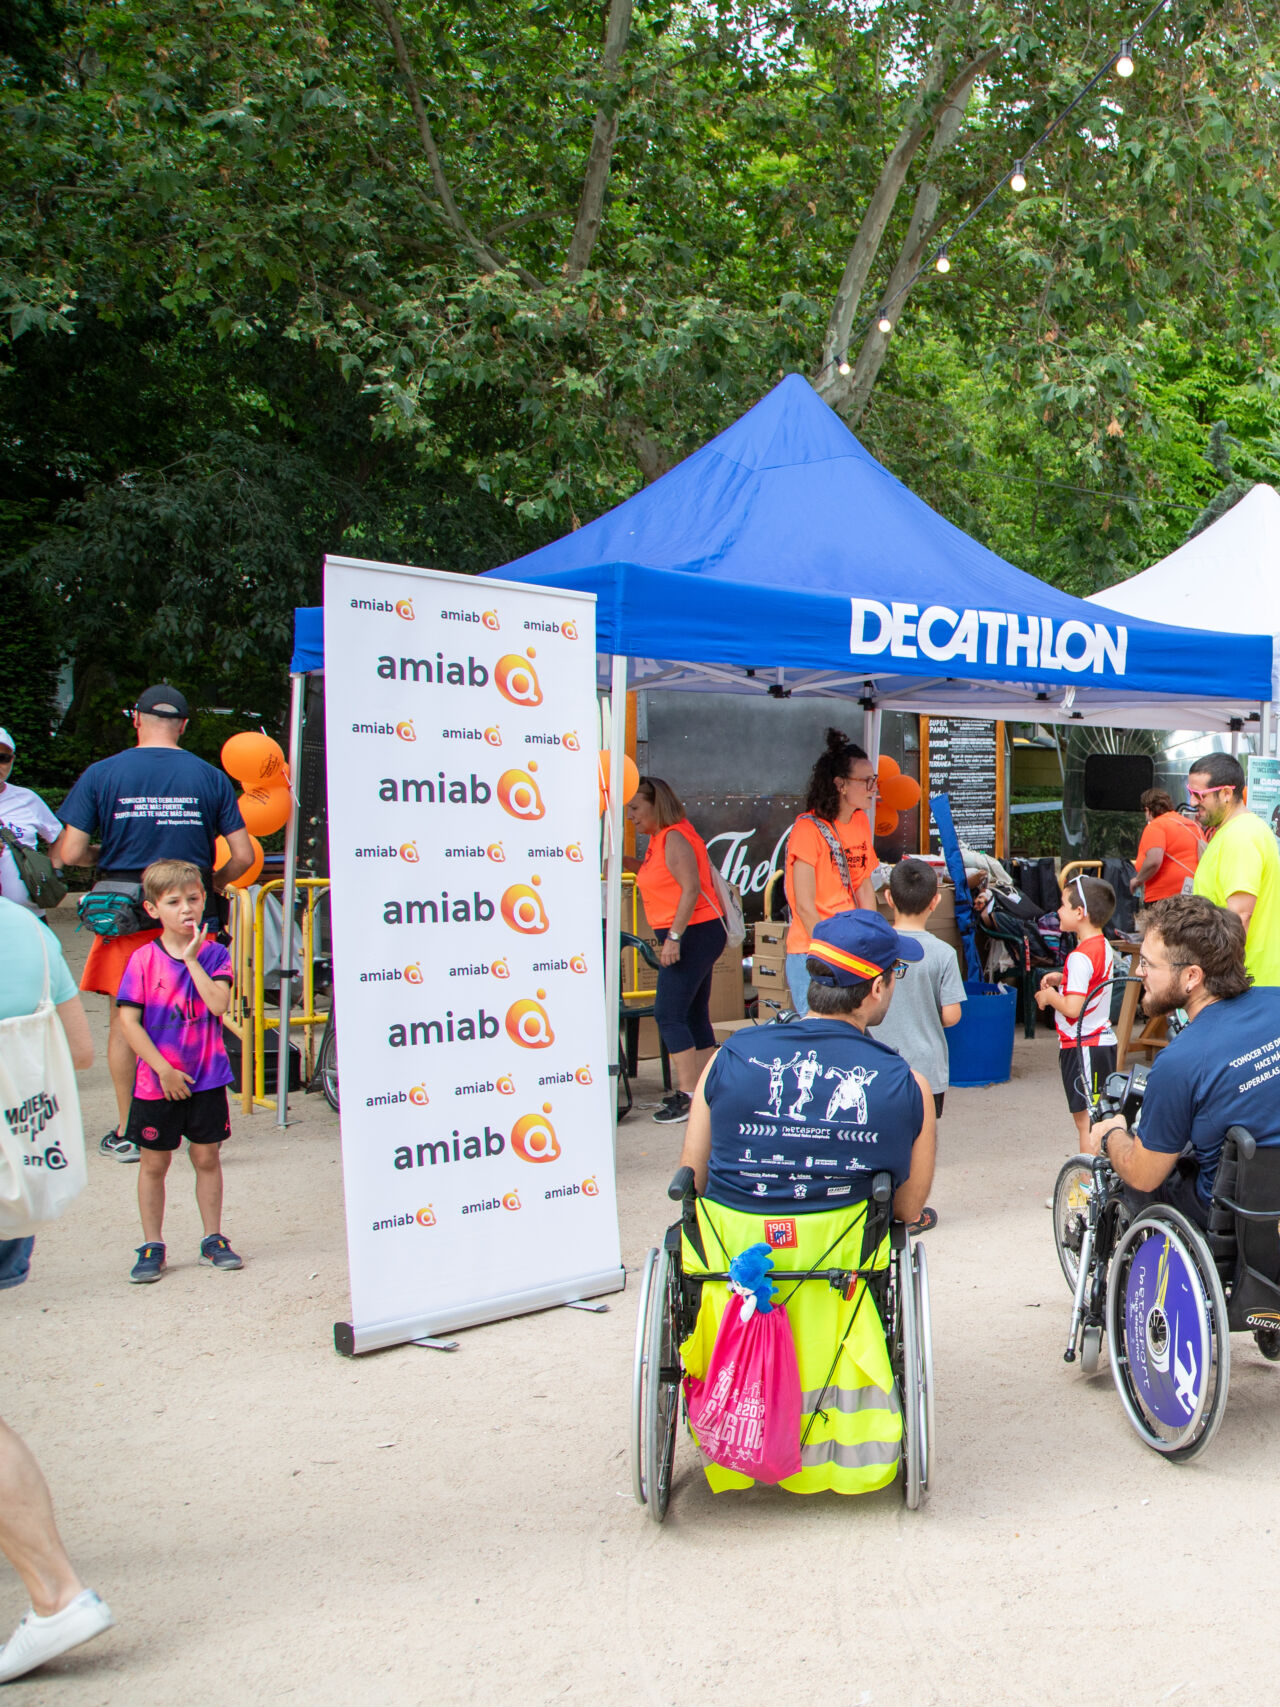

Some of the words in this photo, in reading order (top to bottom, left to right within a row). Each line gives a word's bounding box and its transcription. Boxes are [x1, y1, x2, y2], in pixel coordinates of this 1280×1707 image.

[350, 598, 394, 613] amiab
[440, 610, 480, 623] amiab
[523, 620, 559, 633] amiab
[850, 598, 1128, 675] DECATHLON
[377, 652, 489, 688] amiab
[352, 722, 394, 735] amiab
[442, 729, 482, 740] amiab
[525, 733, 561, 745] amiab
[379, 771, 491, 805] amiab
[355, 845, 397, 858] amiab
[445, 846, 485, 857] amiab
[528, 846, 564, 858] amiab
[383, 891, 494, 925] amiab
[449, 963, 489, 977] amiab
[533, 959, 568, 972] amiab
[360, 968, 402, 982] amiab
[388, 1009, 499, 1048] amiab
[1262, 1044, 1275, 1055] TUS
[1254, 1058, 1271, 1071] HACE
[538, 1072, 574, 1086] amiab
[1239, 1068, 1280, 1093] SUPERARLAS
[455, 1081, 494, 1096] amiab
[366, 1091, 407, 1107] amiab
[394, 1126, 505, 1170] amiab
[544, 1184, 580, 1200] amiab
[462, 1198, 501, 1215] amiab
[372, 1213, 414, 1231] amiab
